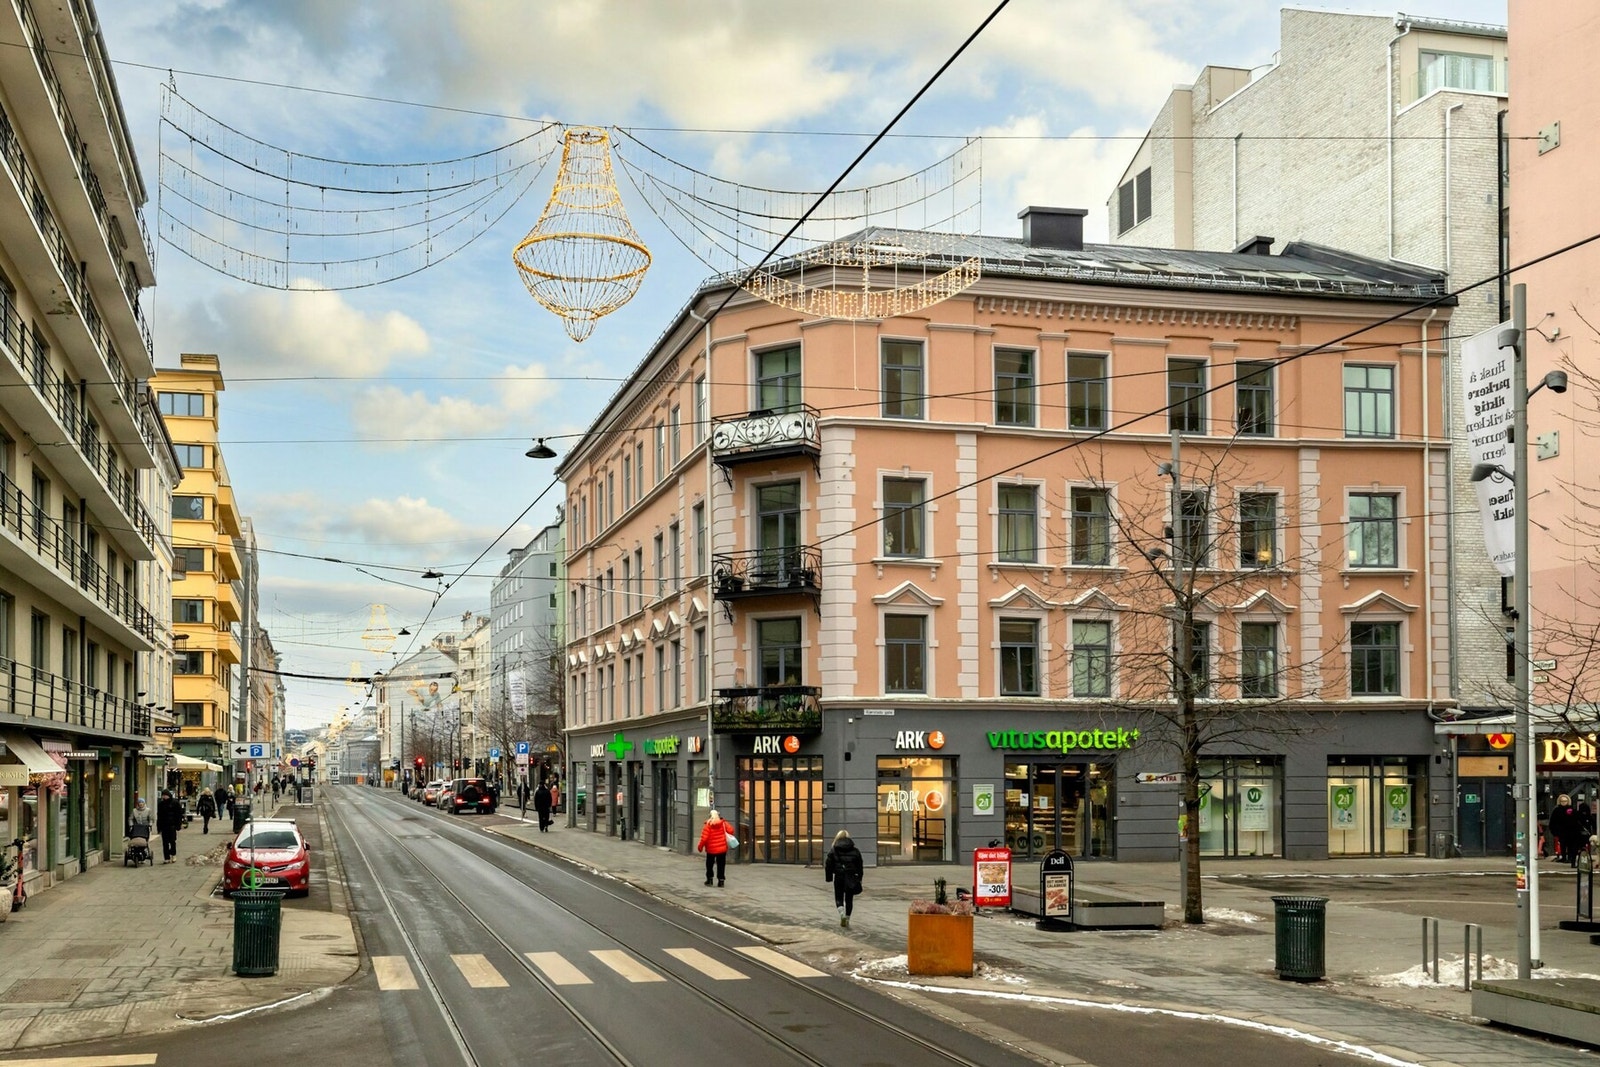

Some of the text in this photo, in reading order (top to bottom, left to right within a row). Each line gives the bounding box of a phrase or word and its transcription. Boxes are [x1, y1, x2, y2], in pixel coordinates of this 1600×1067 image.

[157, 726, 180, 734] GANT
[753, 735, 782, 753] ARK
[895, 731, 925, 750] ARK
[1542, 734, 1598, 763] Deli
[885, 791, 920, 811] ARK
[1249, 791, 1259, 799] VI
[988, 885, 1007, 893] -30%
